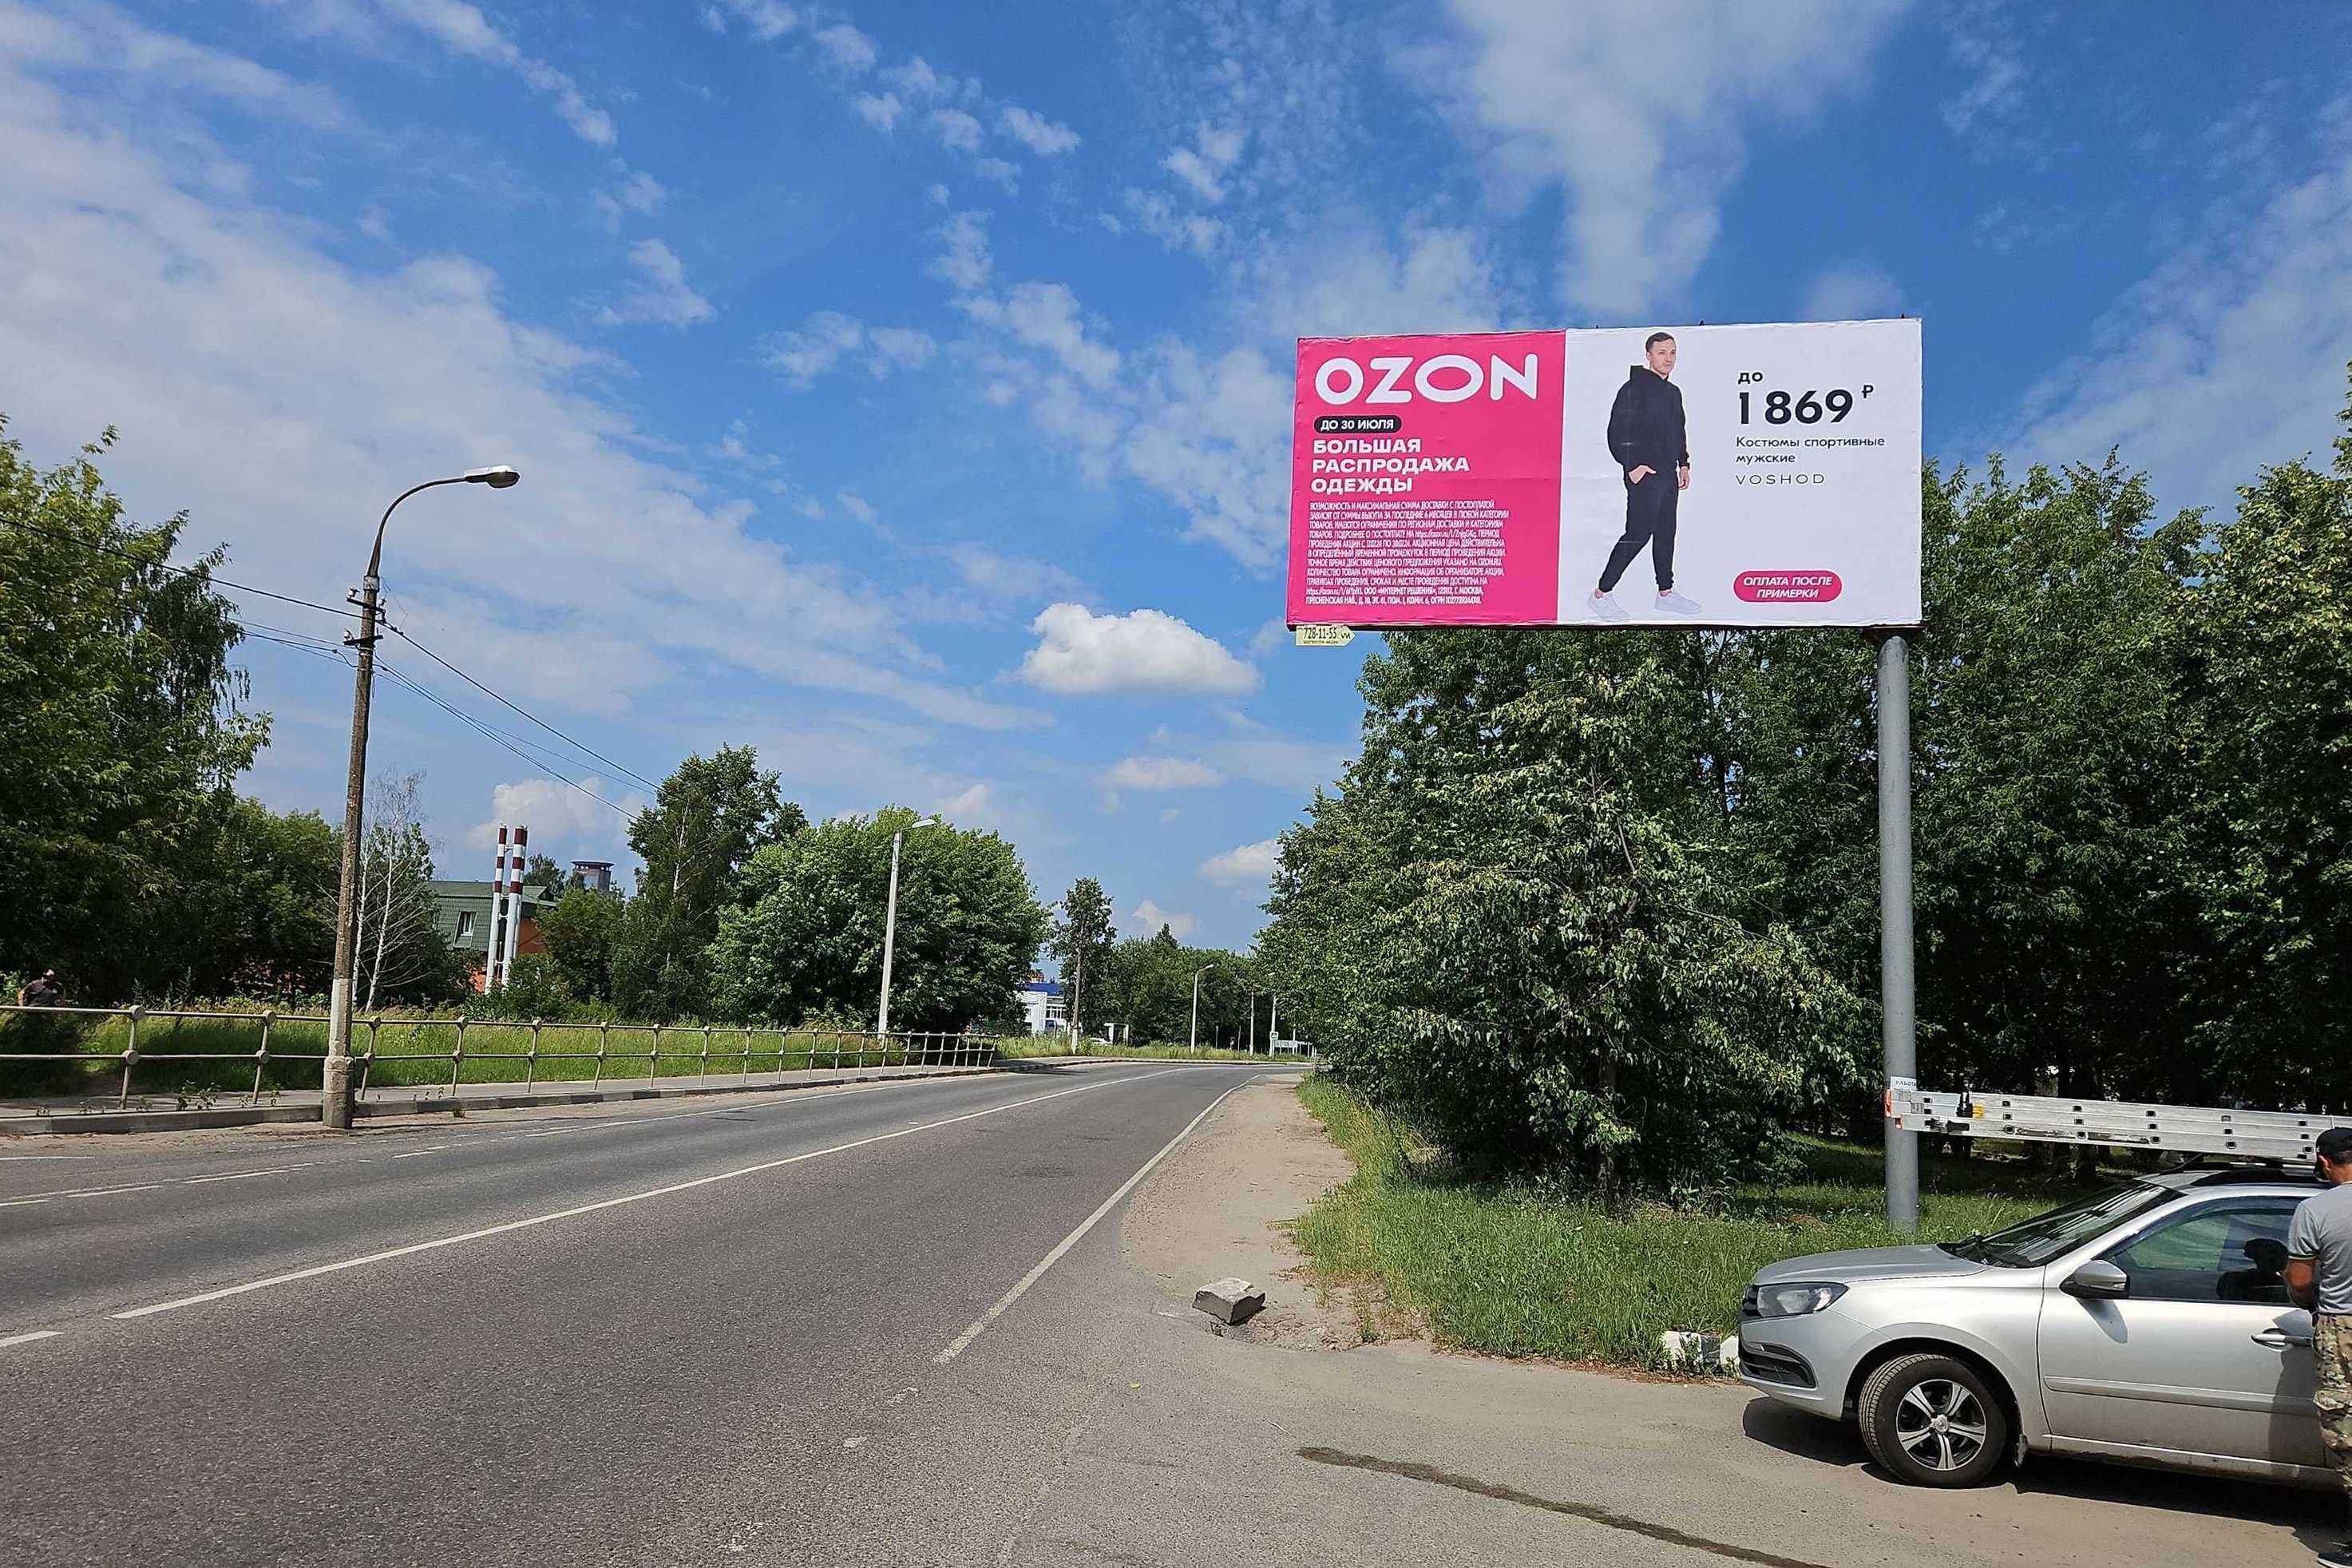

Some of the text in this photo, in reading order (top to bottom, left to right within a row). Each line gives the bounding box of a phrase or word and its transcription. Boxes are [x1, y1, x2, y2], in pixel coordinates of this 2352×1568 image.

[1315, 354, 1538, 405] OZON
[1764, 389, 1853, 425] 869
[1321, 419, 1394, 431] ДО 30 ИЮЛЯ
[1313, 439, 1421, 454] БОЛЬШАЯ
[1736, 436, 1885, 449] Костюмы спортивные
[1313, 457, 1470, 474] РАСПРОДАЖА
[1736, 454, 1796, 465] мужские
[1736, 473, 1825, 485] VOSHOD
[1311, 477, 1413, 495] ОДЕЖДЫ
[1744, 576, 1833, 586] ОПЛАТА ПОСЛЕ
[1756, 589, 1819, 598] ПРИМЕРКИ
[1304, 628, 1337, 639] 728-11-55
